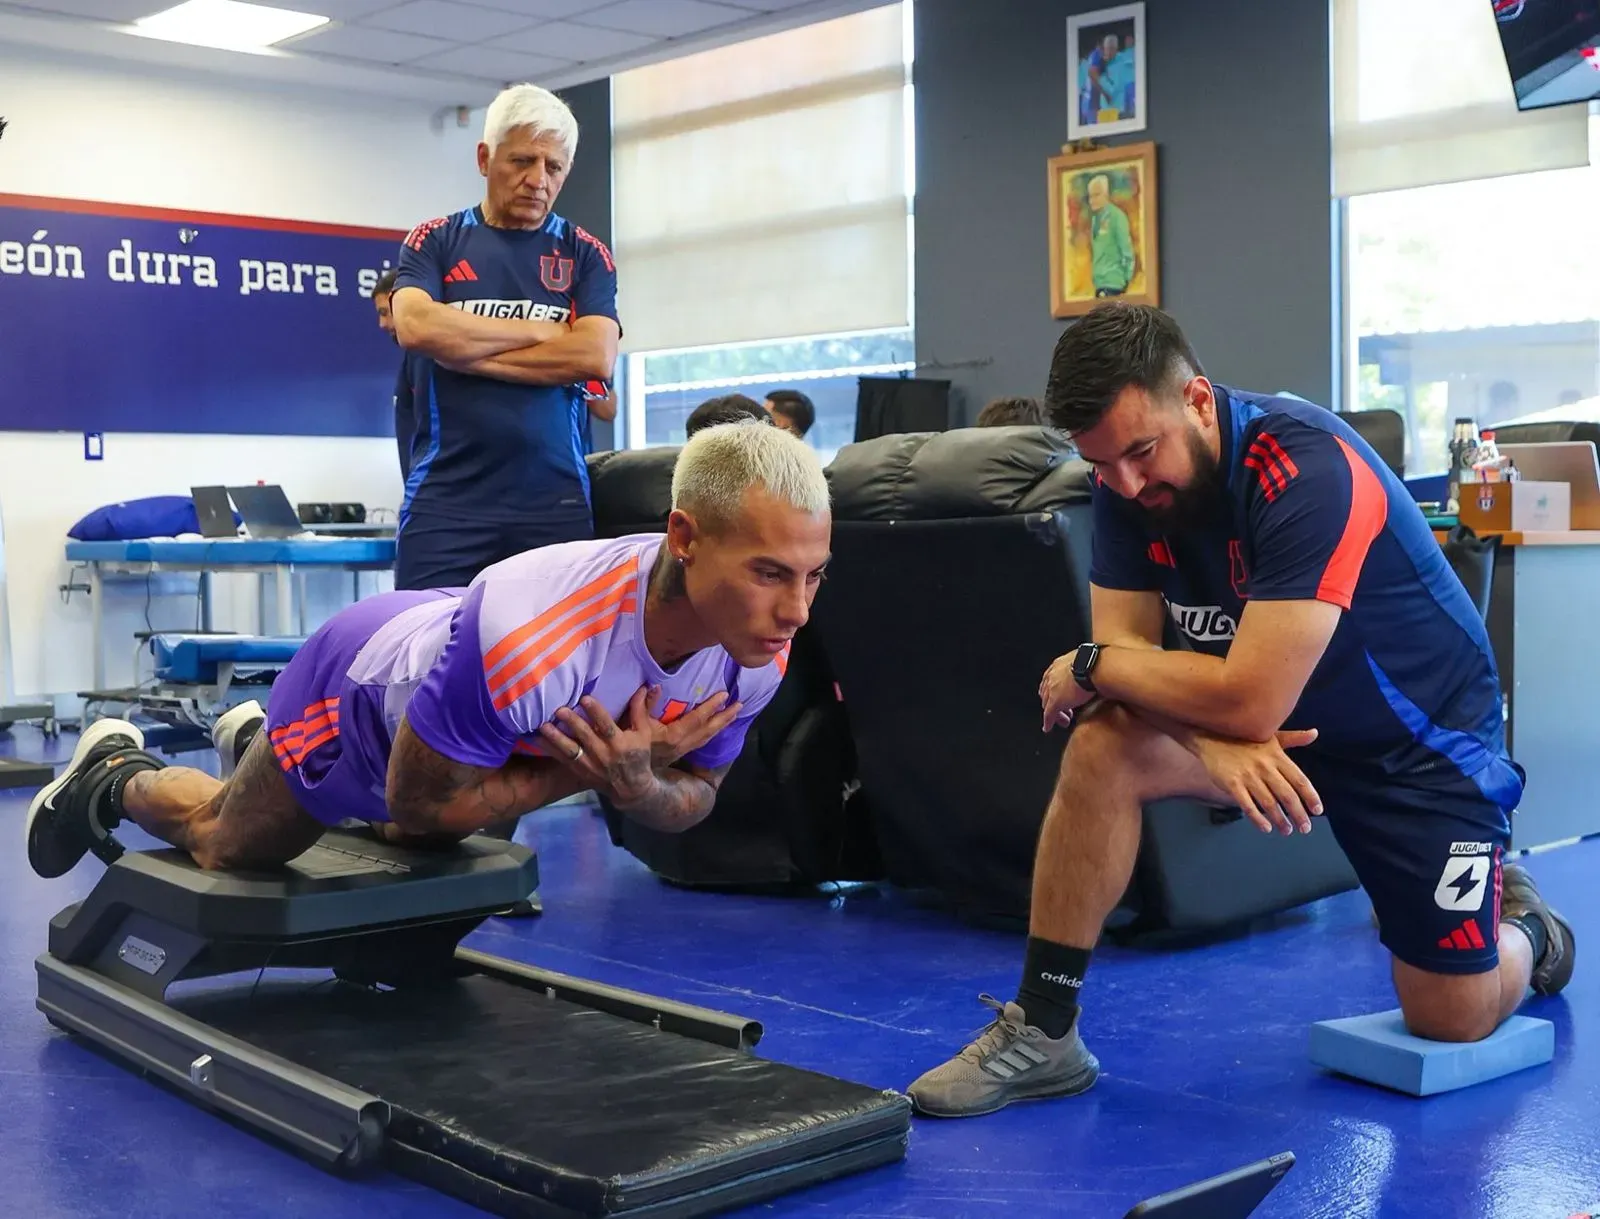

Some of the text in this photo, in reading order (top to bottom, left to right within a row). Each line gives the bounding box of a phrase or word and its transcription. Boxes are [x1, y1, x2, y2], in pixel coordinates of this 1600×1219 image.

[0, 230, 85, 279] eón
[108, 239, 218, 288] dura
[239, 259, 339, 296] para
[1177, 609, 1235, 636] JUG
[1040, 971, 1083, 988] adida
